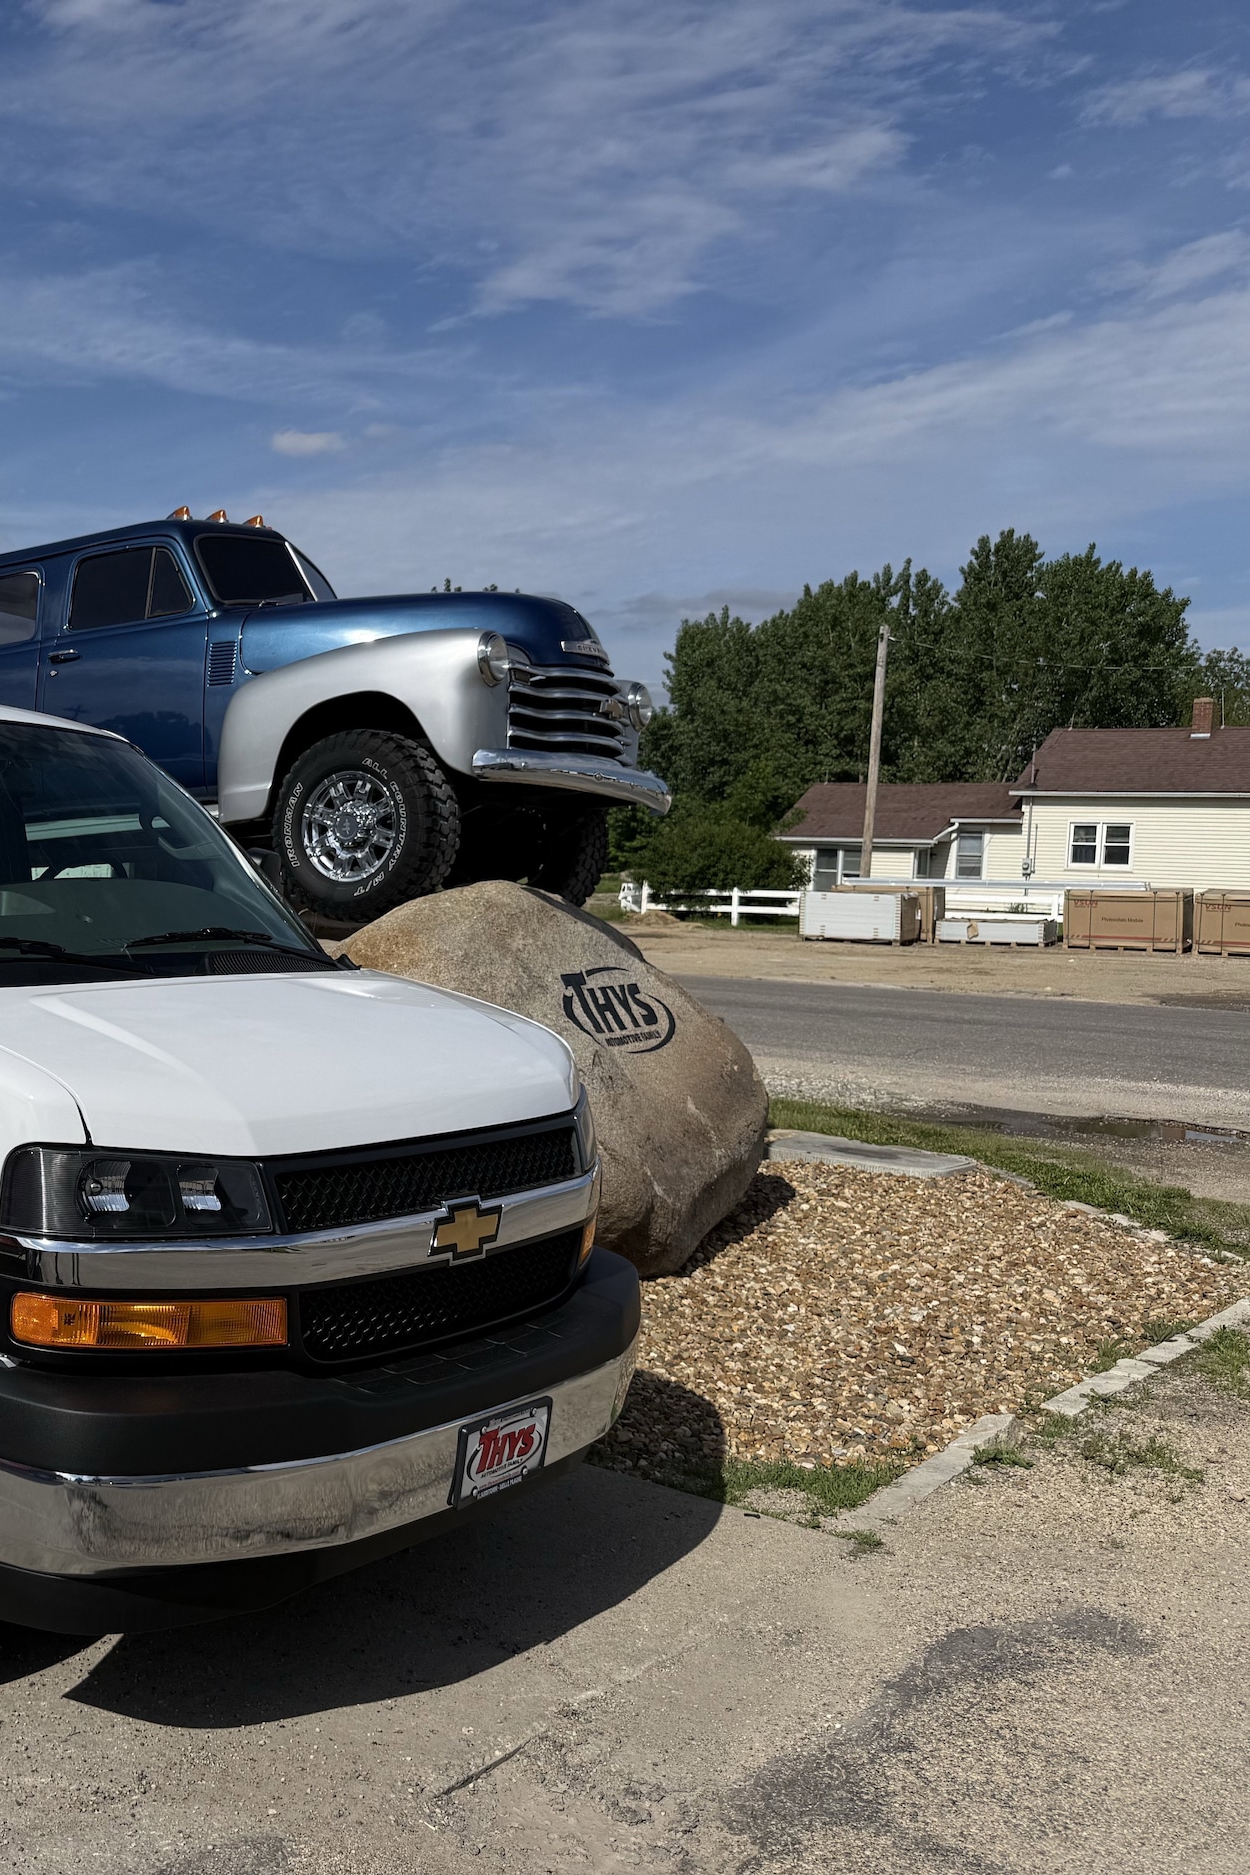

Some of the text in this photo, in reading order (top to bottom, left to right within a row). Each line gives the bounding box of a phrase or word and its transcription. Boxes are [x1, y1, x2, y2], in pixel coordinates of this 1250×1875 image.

[283, 781, 304, 868] IRONMAN
[353, 757, 407, 897] ALL COUNTRY M/T
[560, 970, 659, 1034] THYS
[476, 1423, 537, 1475] THYS
[508, 1458, 523, 1466] FAMILY
